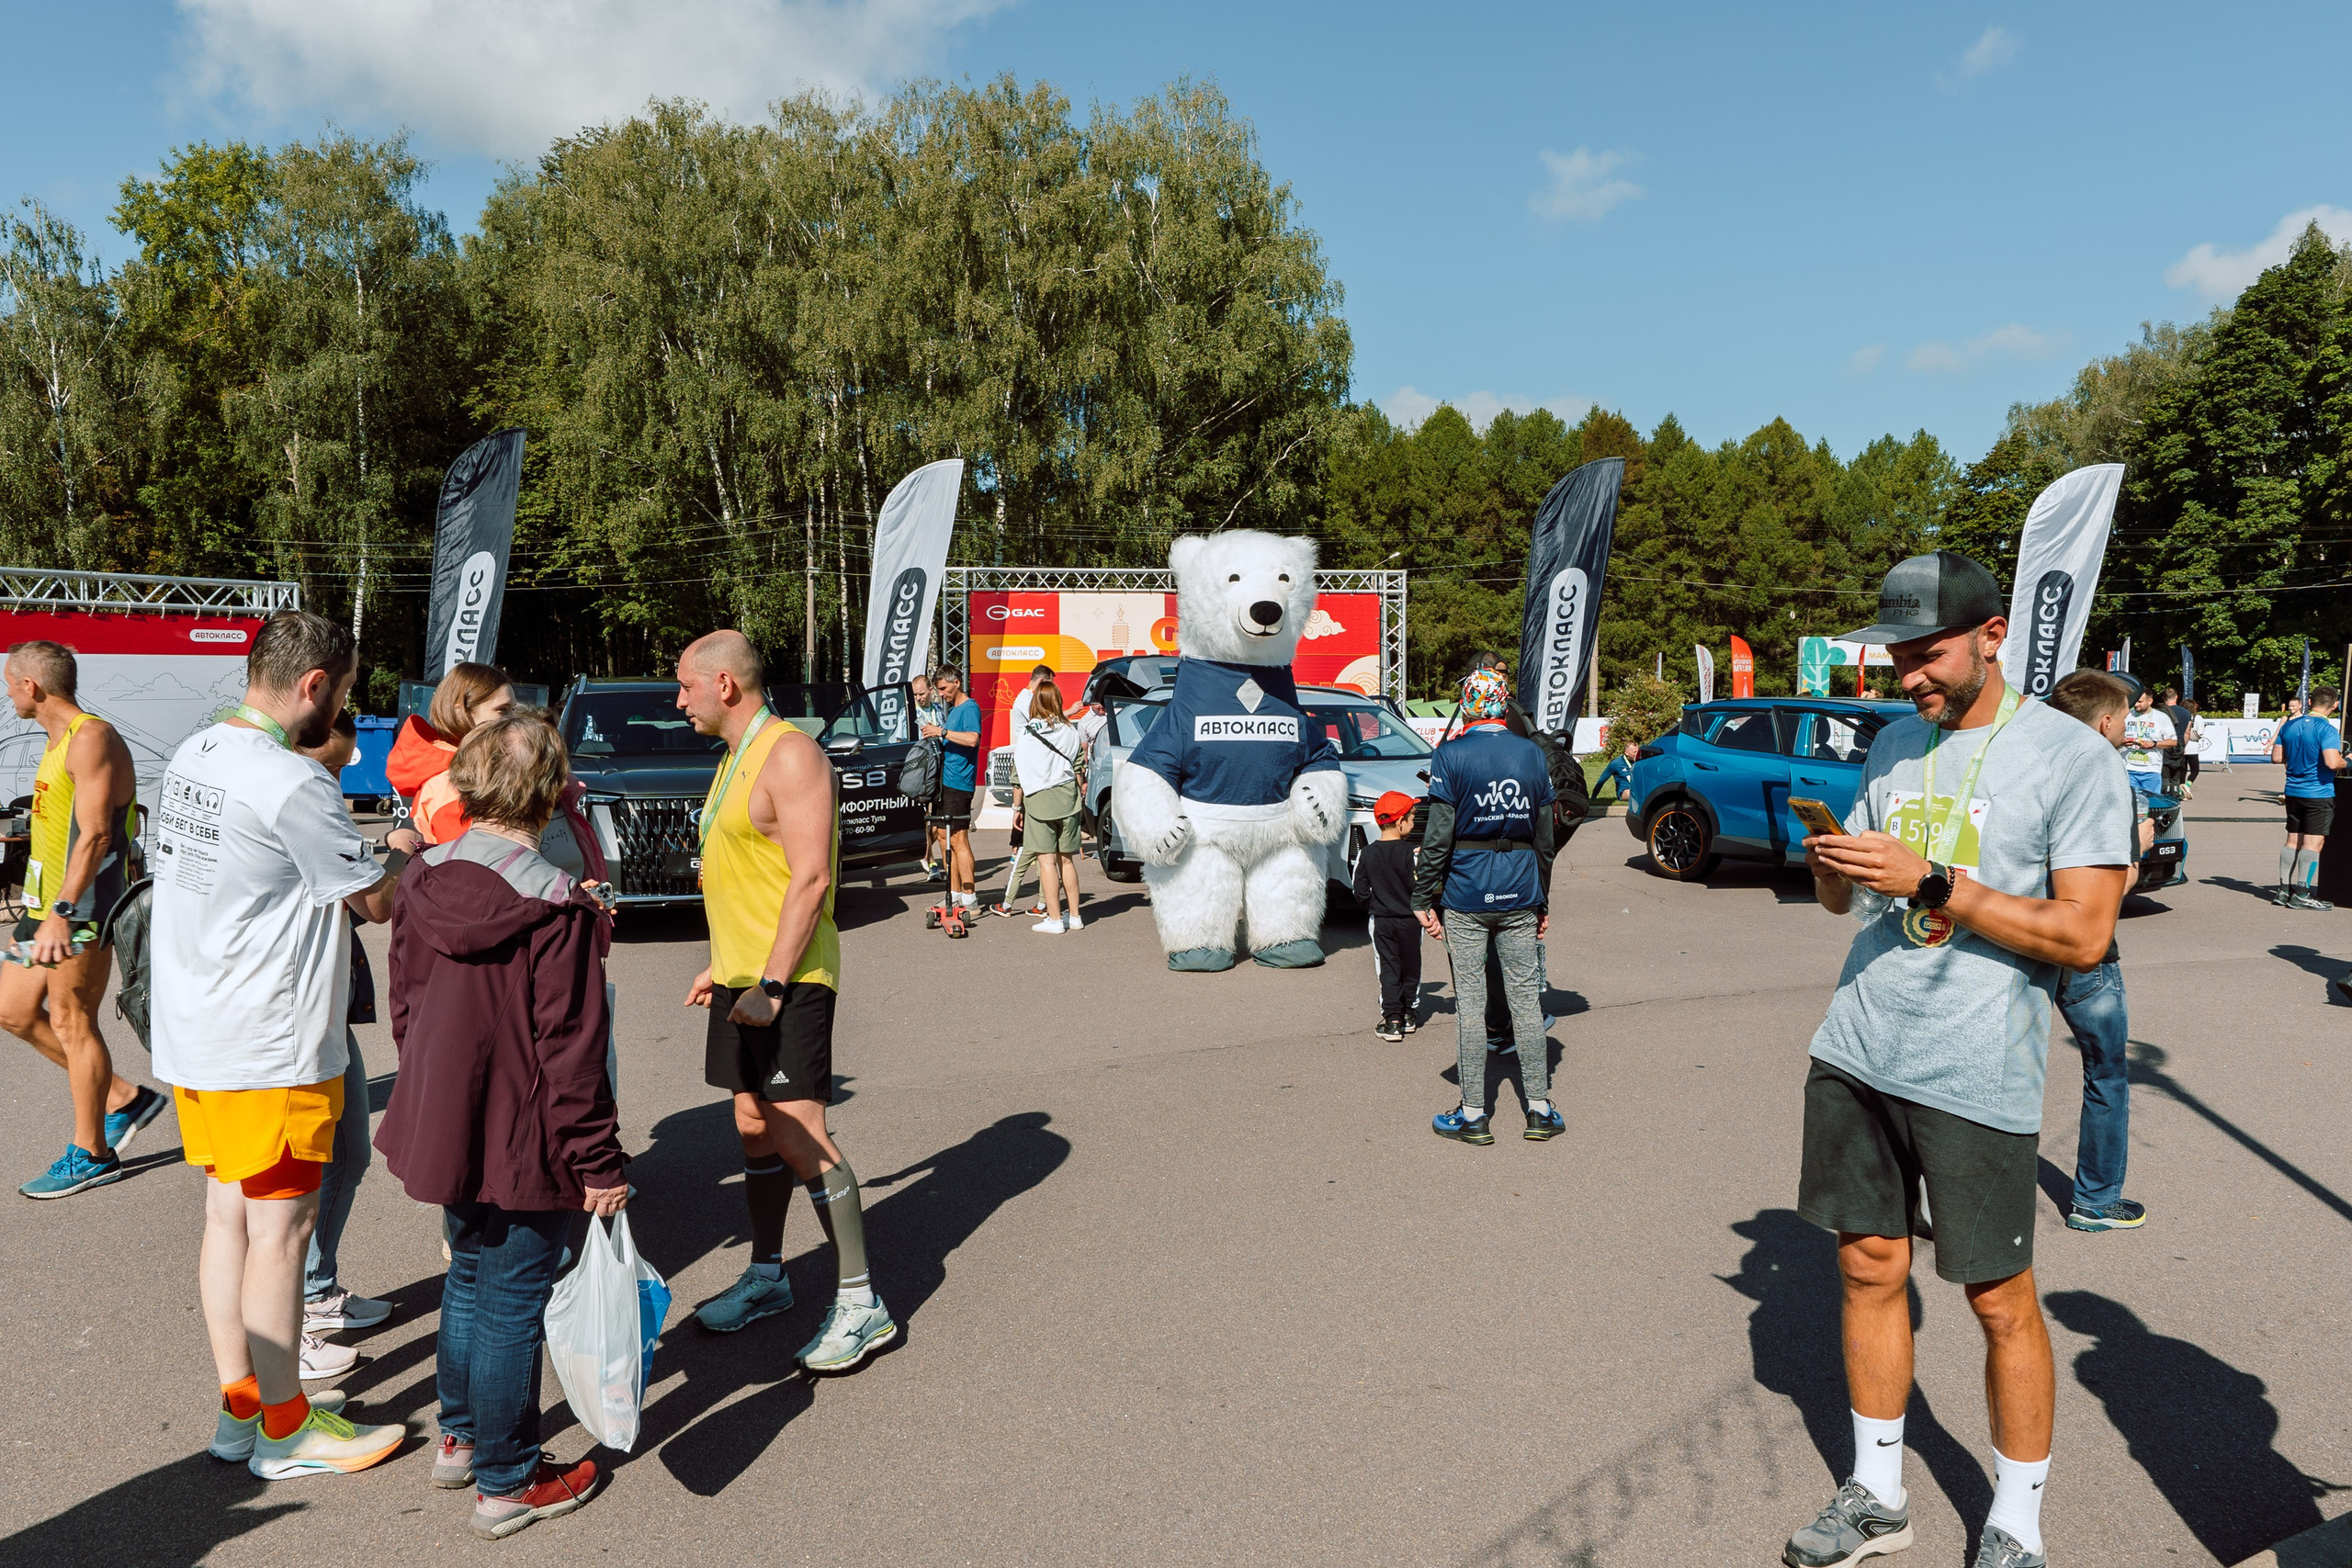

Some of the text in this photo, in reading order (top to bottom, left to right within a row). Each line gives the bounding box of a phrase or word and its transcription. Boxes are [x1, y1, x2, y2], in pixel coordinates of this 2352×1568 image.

[1012, 608, 1045, 617] GAC
[195, 632, 243, 640] АВТОКЛАСС
[2030, 585, 2063, 696] ОКЛАСС
[879, 581, 919, 730] АВТОКЛАСС
[1546, 583, 1577, 731] АВТОКЛАСС
[1200, 721, 1295, 736] АВТОКЛАСС
[870, 815, 887, 824] Тула
[1474, 813, 1504, 822] ТУЛЬСКИЙ
[175, 818, 188, 830] БЕГ
[189, 822, 195, 833] В
[195, 825, 220, 840] СЕБЕ
[845, 825, 876, 835] 70-60-90
[2159, 846, 2177, 855] GS3
